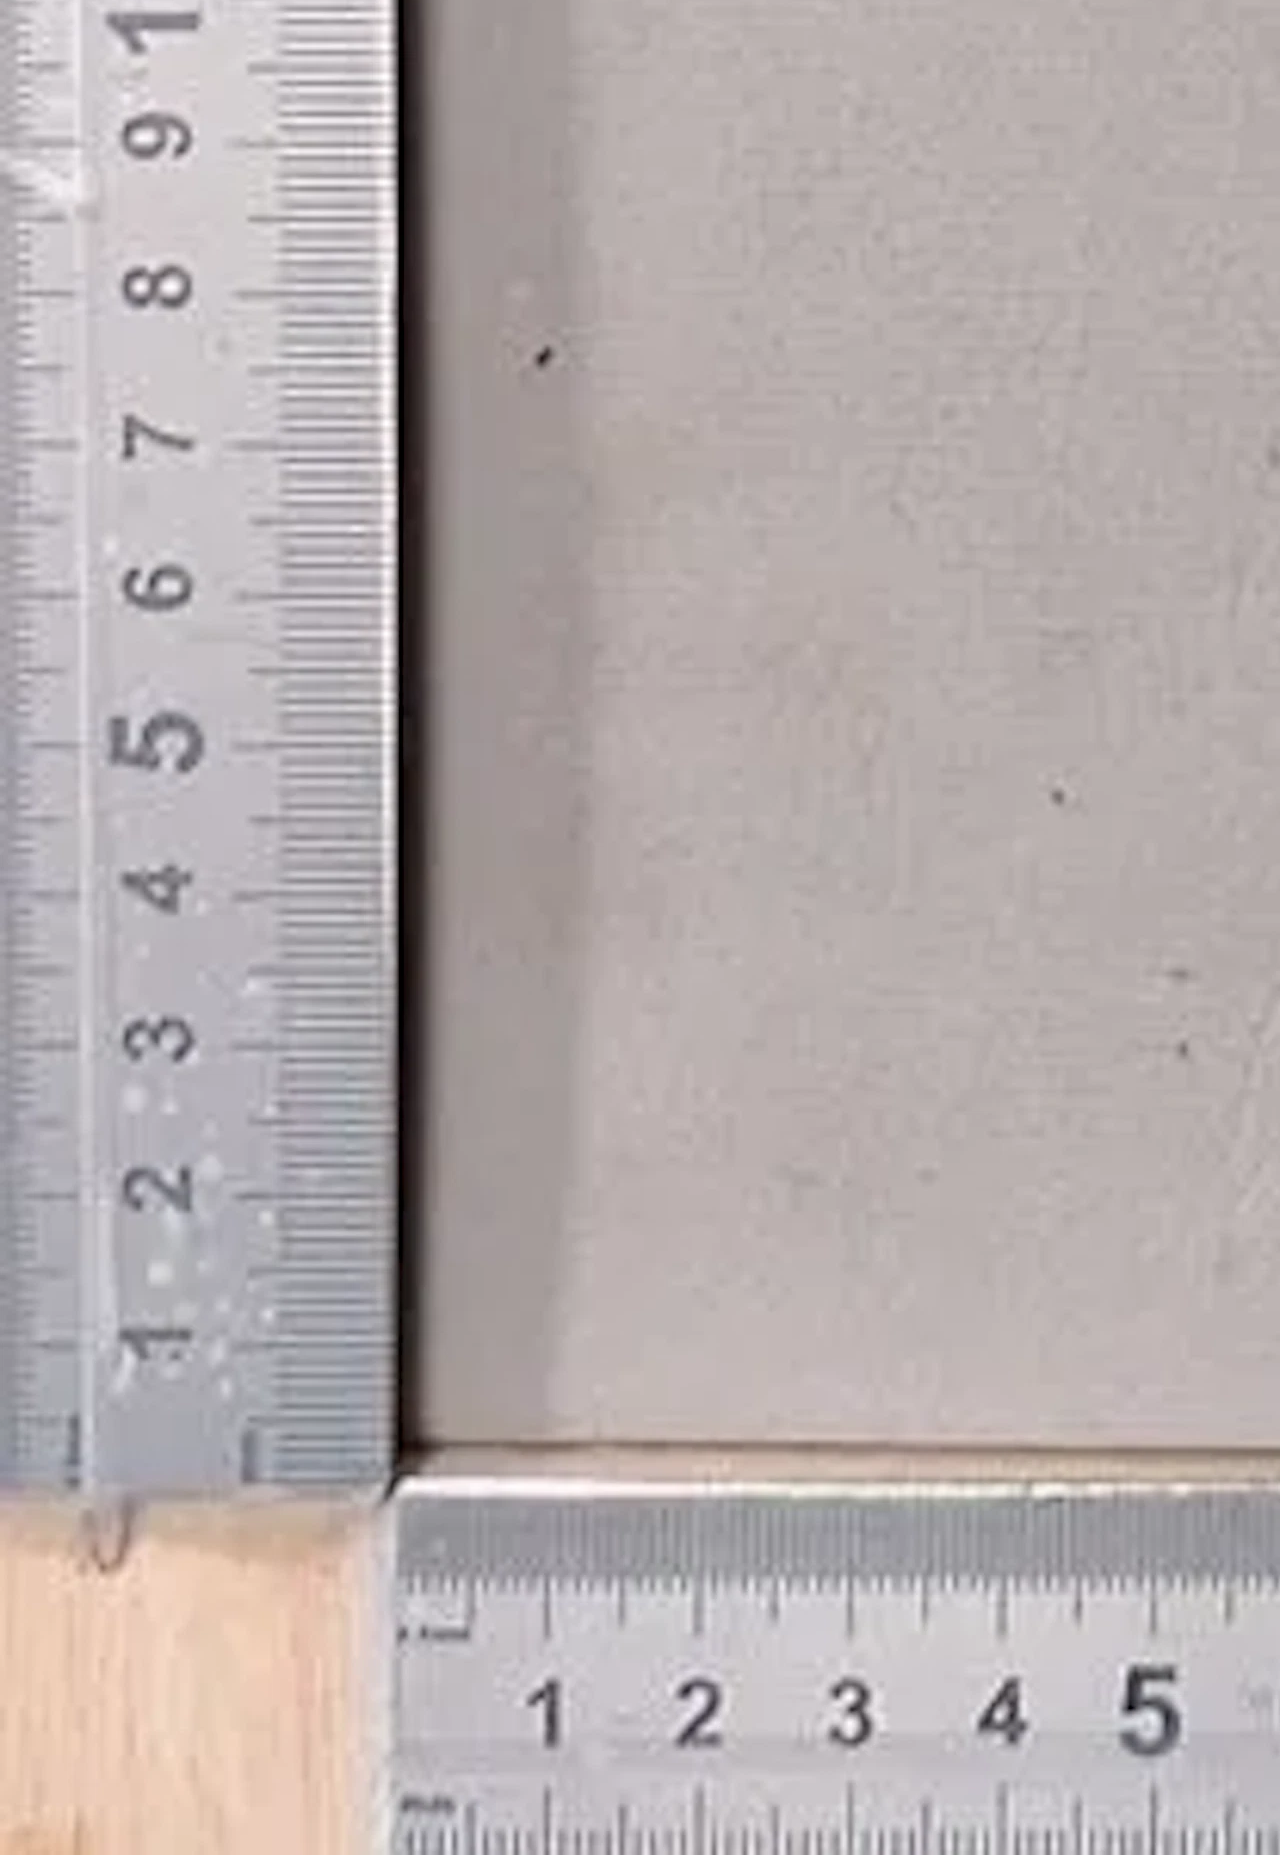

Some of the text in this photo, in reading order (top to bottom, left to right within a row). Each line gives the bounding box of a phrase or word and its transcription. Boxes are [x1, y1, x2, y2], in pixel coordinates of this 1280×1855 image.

[120, 112, 193, 160] 9
[120, 264, 193, 310] 8
[121, 414, 195, 461] 7
[121, 564, 193, 612] 6
[107, 711, 204, 774] 5
[119, 864, 193, 914] 4
[121, 1016, 196, 1064] 3
[119, 1165, 193, 1213] 2
[116, 1326, 195, 1362] 1
[526, 1679, 561, 1748] 1
[676, 1678, 722, 1748] 2
[829, 1678, 874, 1748] 3
[977, 1677, 1028, 1745] 4
[1121, 1665, 1180, 1756] 5
